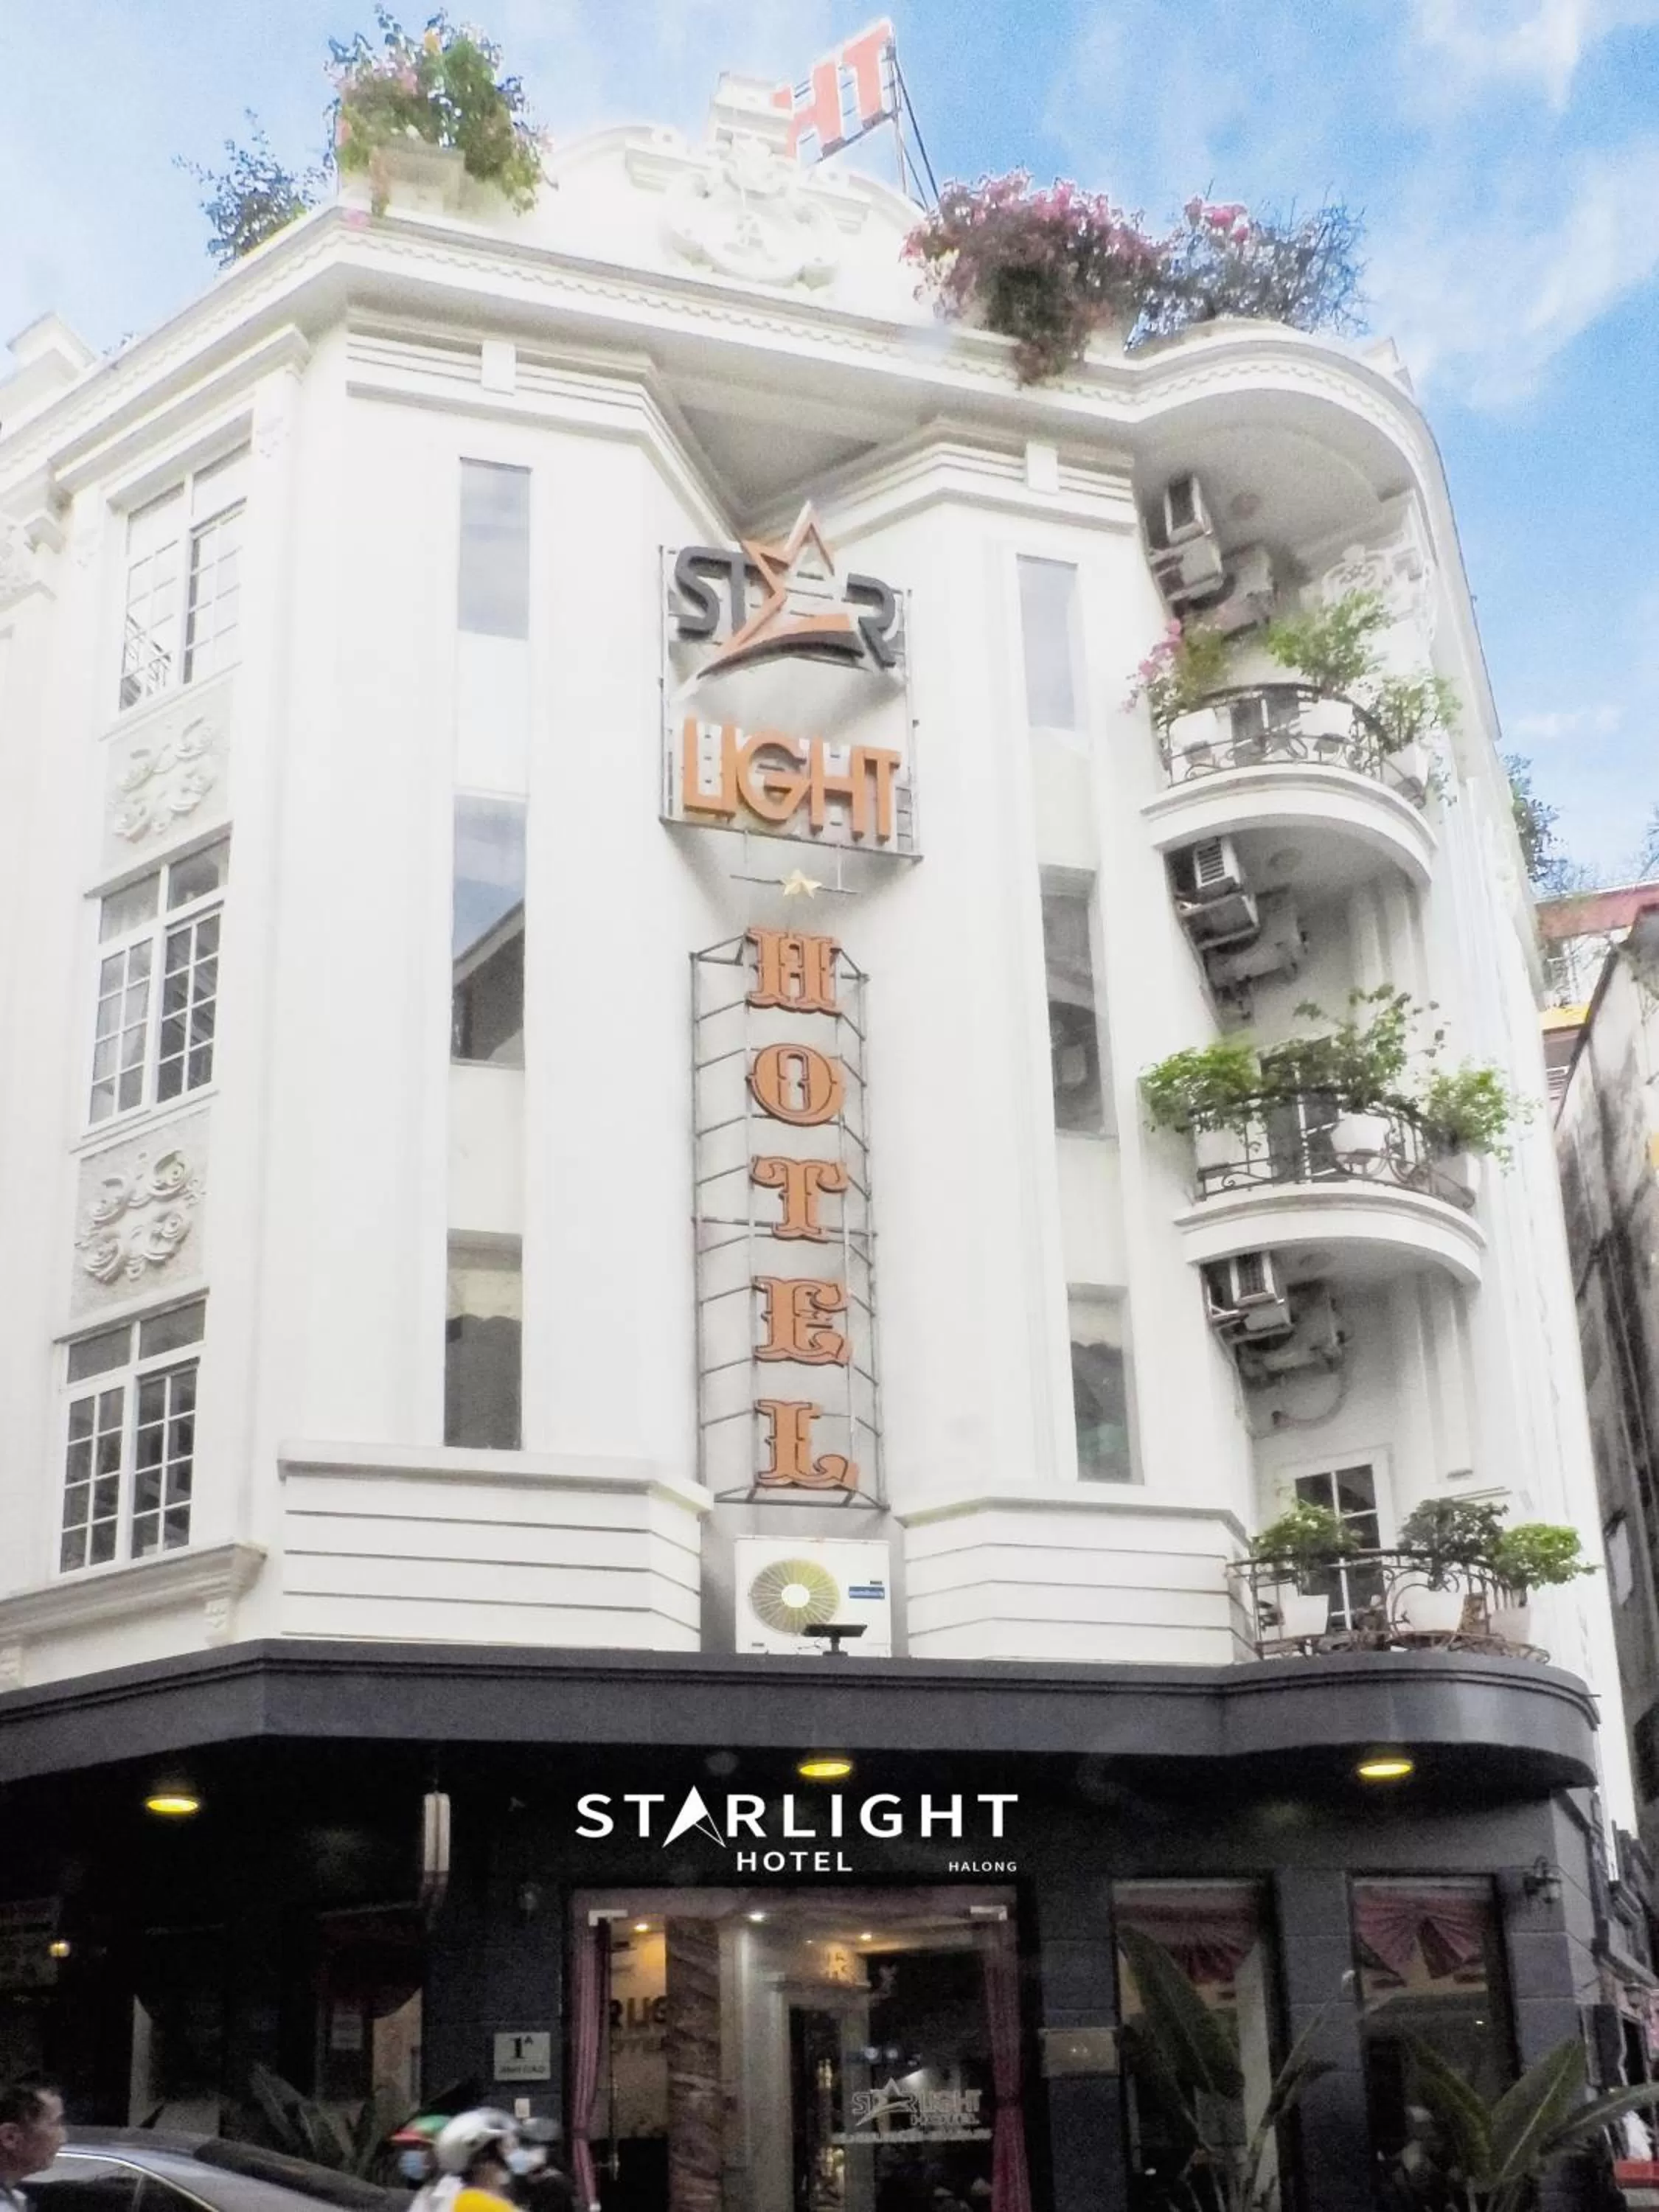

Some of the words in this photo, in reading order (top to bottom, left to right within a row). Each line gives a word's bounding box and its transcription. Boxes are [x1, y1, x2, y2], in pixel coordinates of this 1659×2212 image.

[673, 501, 897, 680] STAR
[682, 714, 901, 842] LIGHT
[746, 927, 858, 1491] HOTEL
[575, 1785, 1019, 1848] STARLIGHT
[737, 1851, 853, 1872] HOTEL
[948, 1860, 1018, 1873] HALONG
